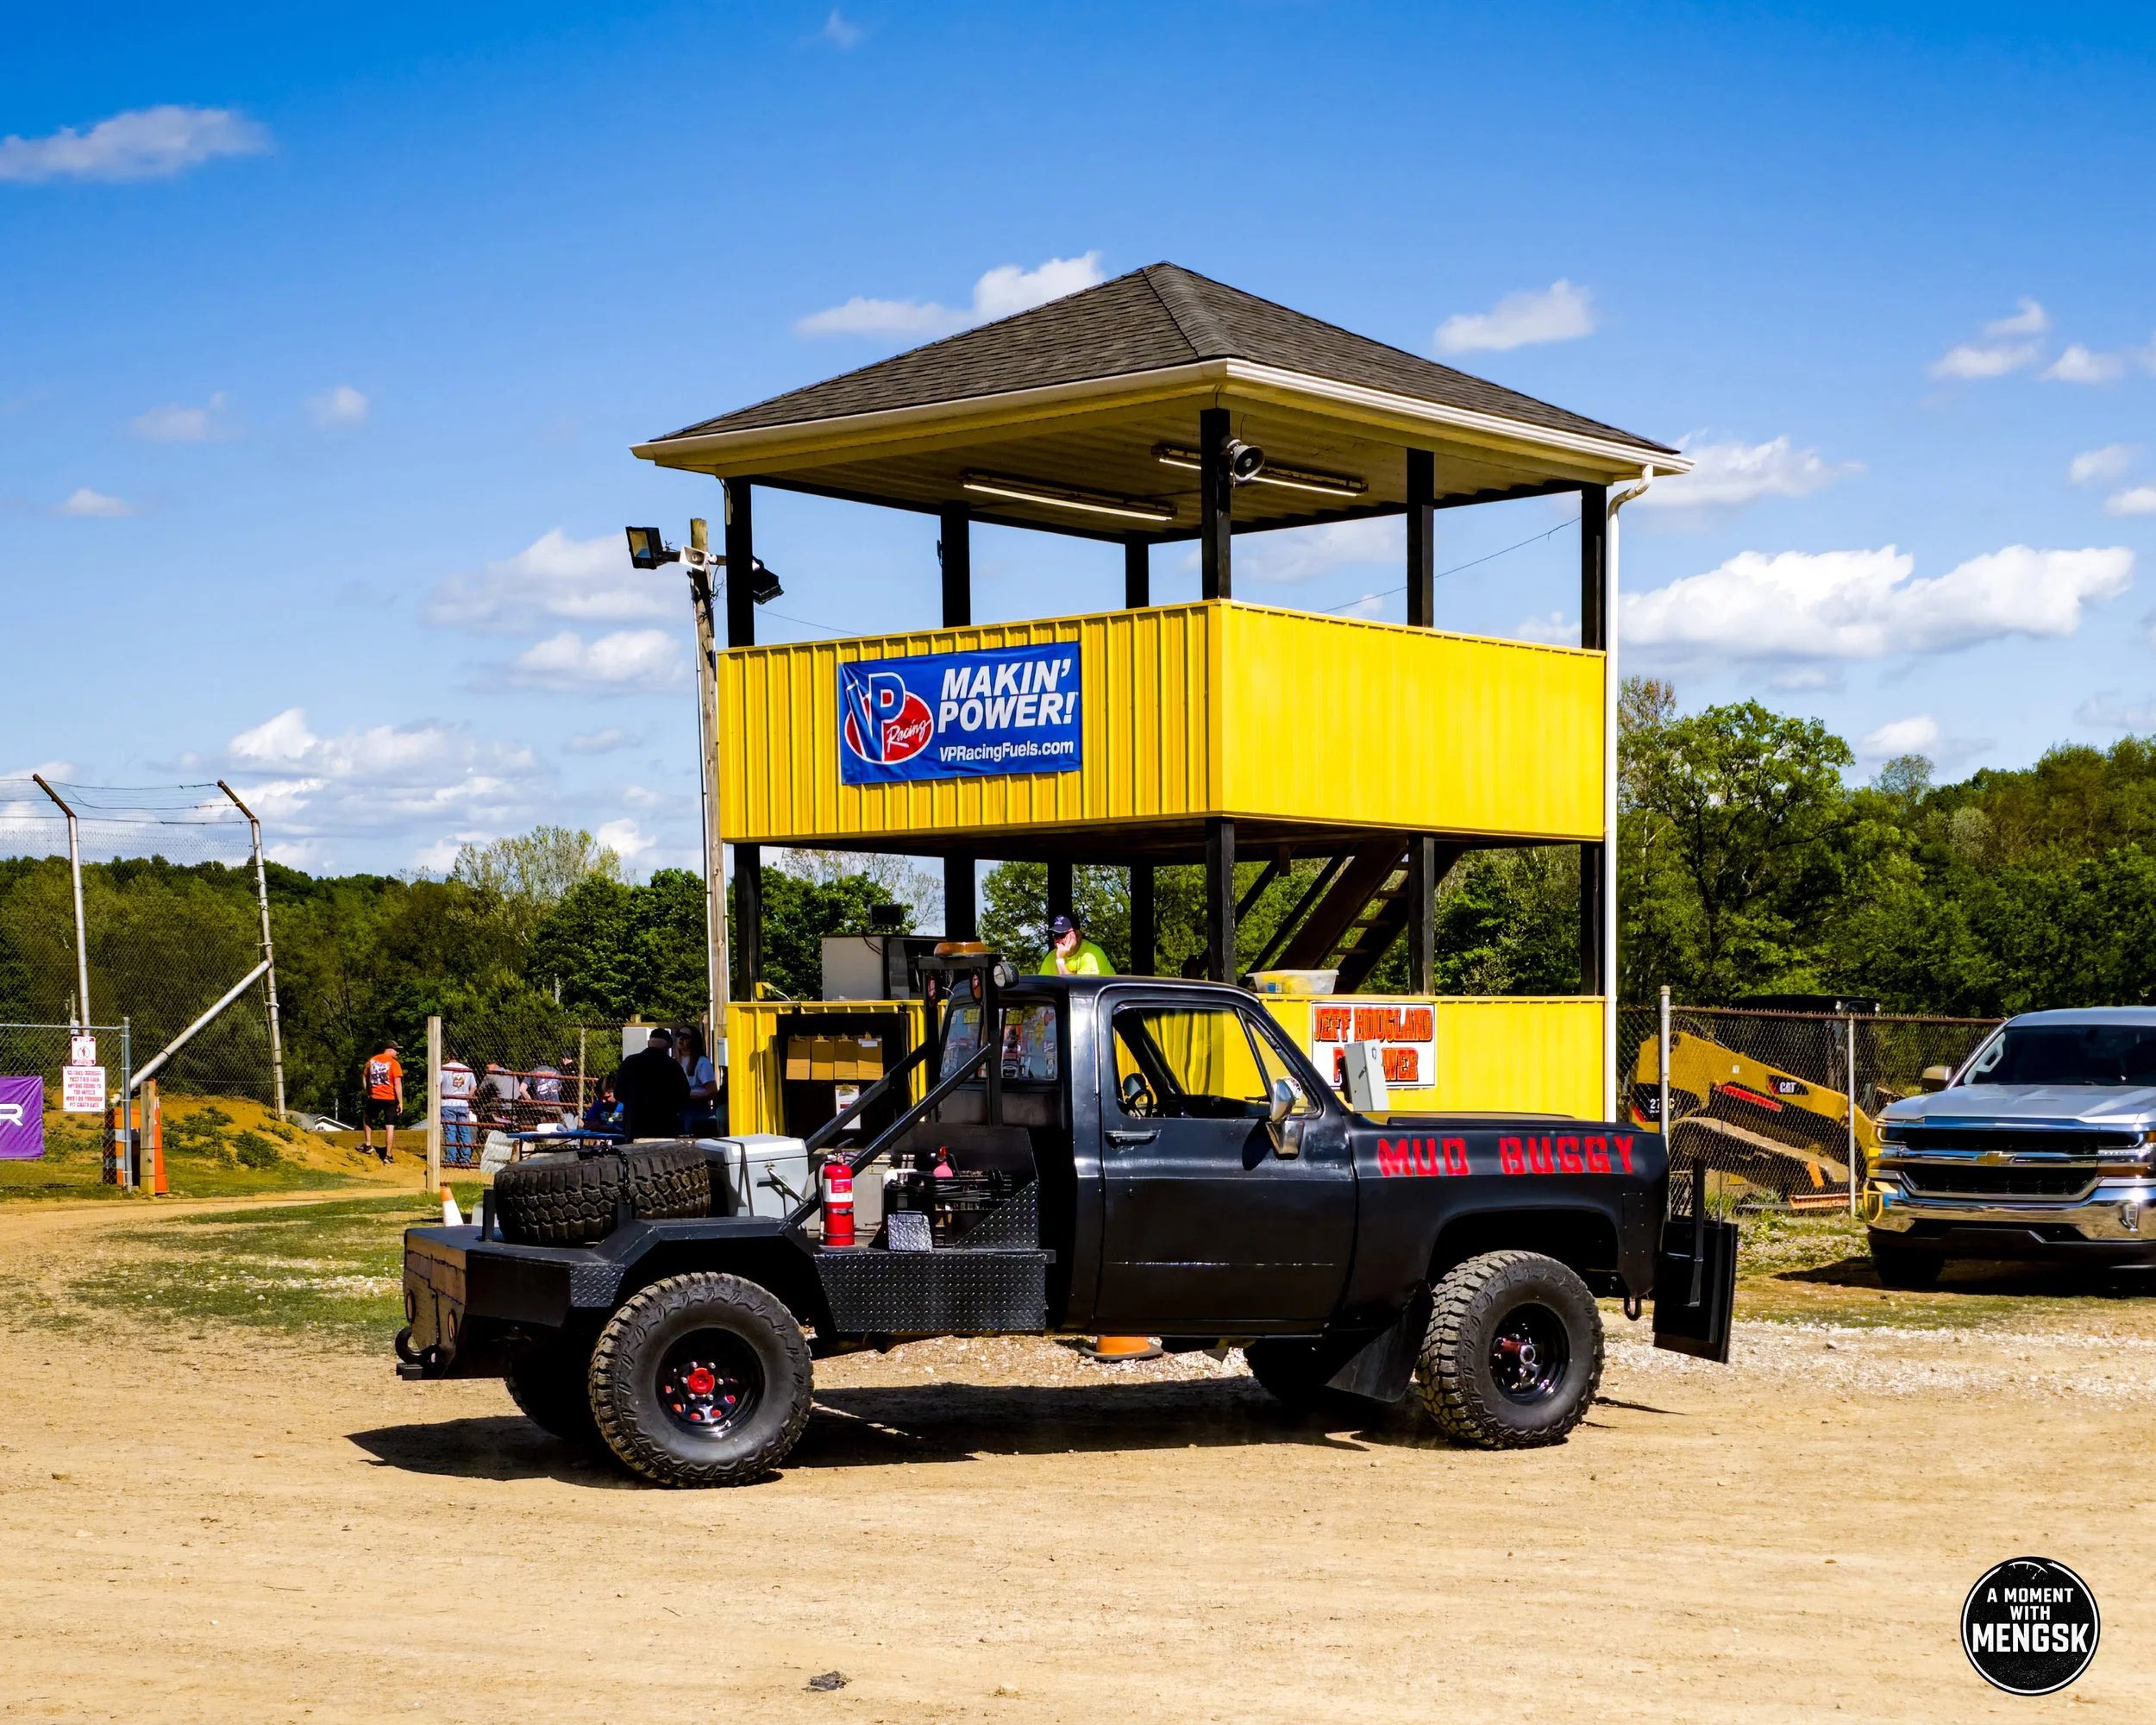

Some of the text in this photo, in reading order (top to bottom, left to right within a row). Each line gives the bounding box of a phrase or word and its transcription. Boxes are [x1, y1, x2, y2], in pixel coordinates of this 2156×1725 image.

[941, 658, 1071, 700] MAKIN'
[937, 692, 1075, 733] POWER!
[886, 718, 932, 753] Racing
[940, 740, 1074, 762] VPRacingFuels.com
[1314, 1007, 1351, 1042] JEFF
[1779, 1082, 1796, 1093] CAT
[1378, 1135, 1634, 1176] MUD BUGGY
